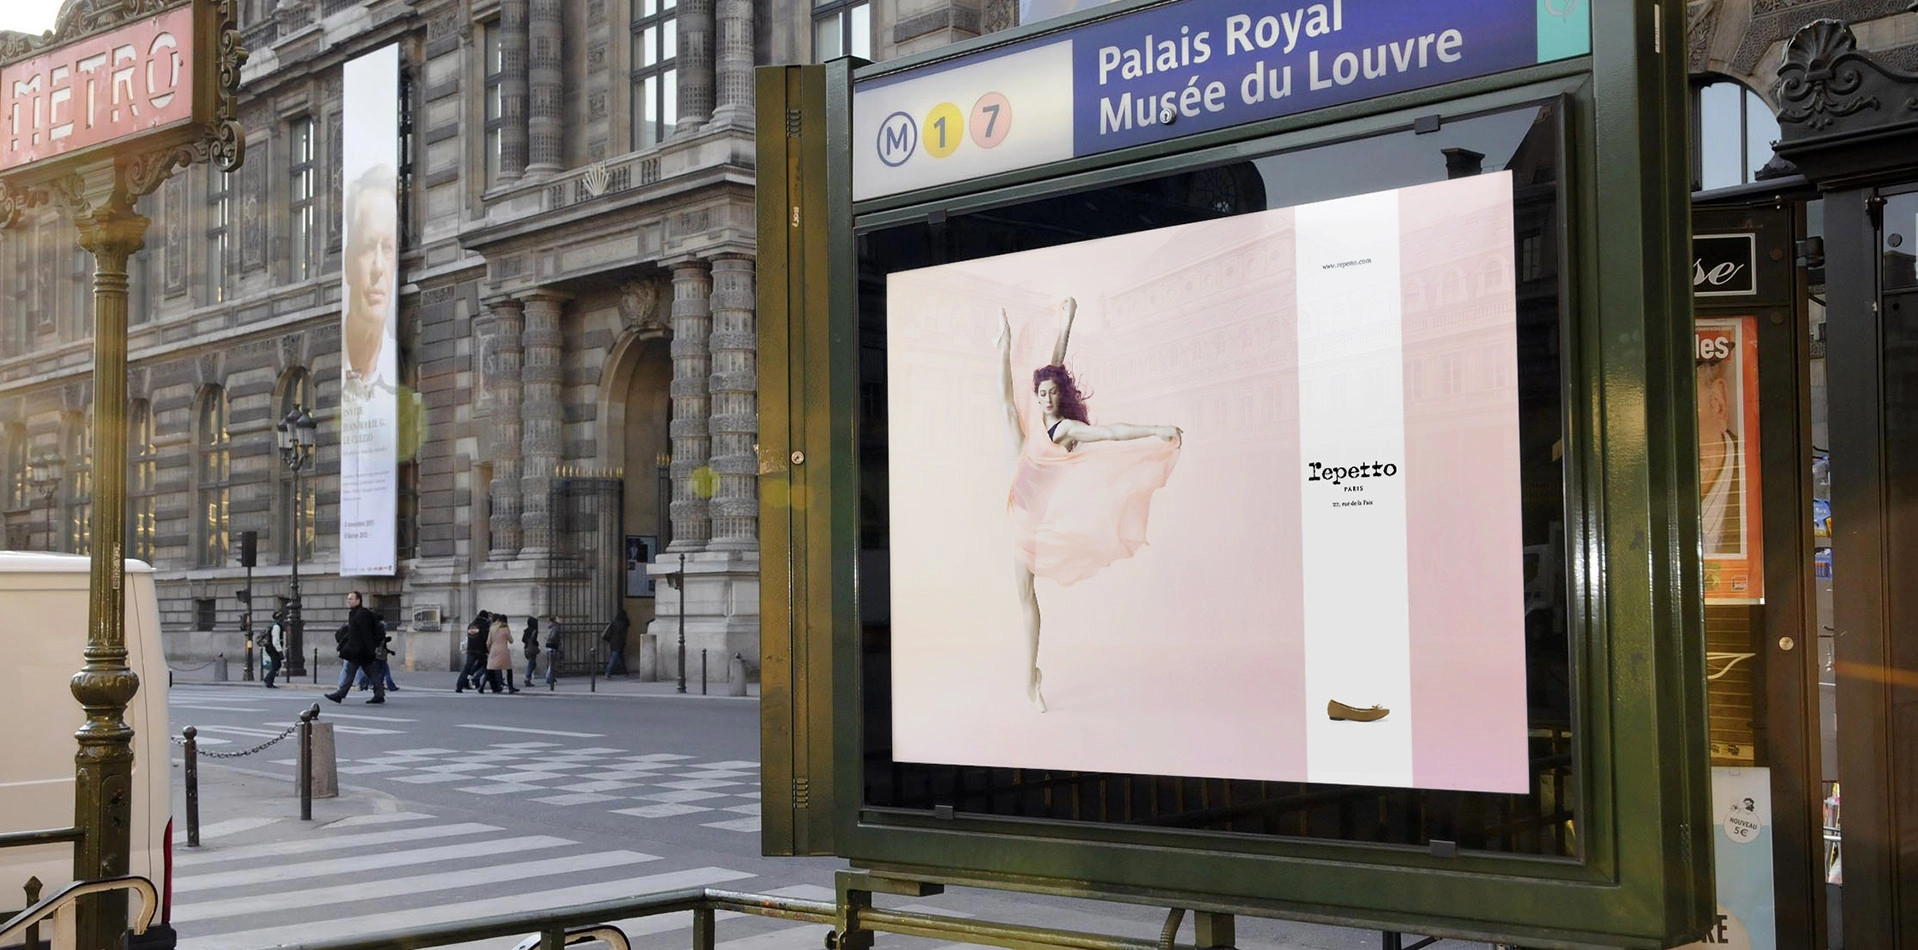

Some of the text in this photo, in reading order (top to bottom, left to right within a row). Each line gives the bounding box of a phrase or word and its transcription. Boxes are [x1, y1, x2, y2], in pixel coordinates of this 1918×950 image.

[1099, 0, 1343, 86] Palais Royal
[11, 31, 179, 151] METRO
[1100, 28, 1463, 135] Musée du Louvre
[933, 116, 946, 148] 1
[982, 104, 1000, 138] 7
[1308, 460, 1397, 485] repetto
[1343, 485, 1364, 493] PARIS
[1729, 817, 1758, 830] NOUVEAU
[1733, 826, 1749, 838] 5€
